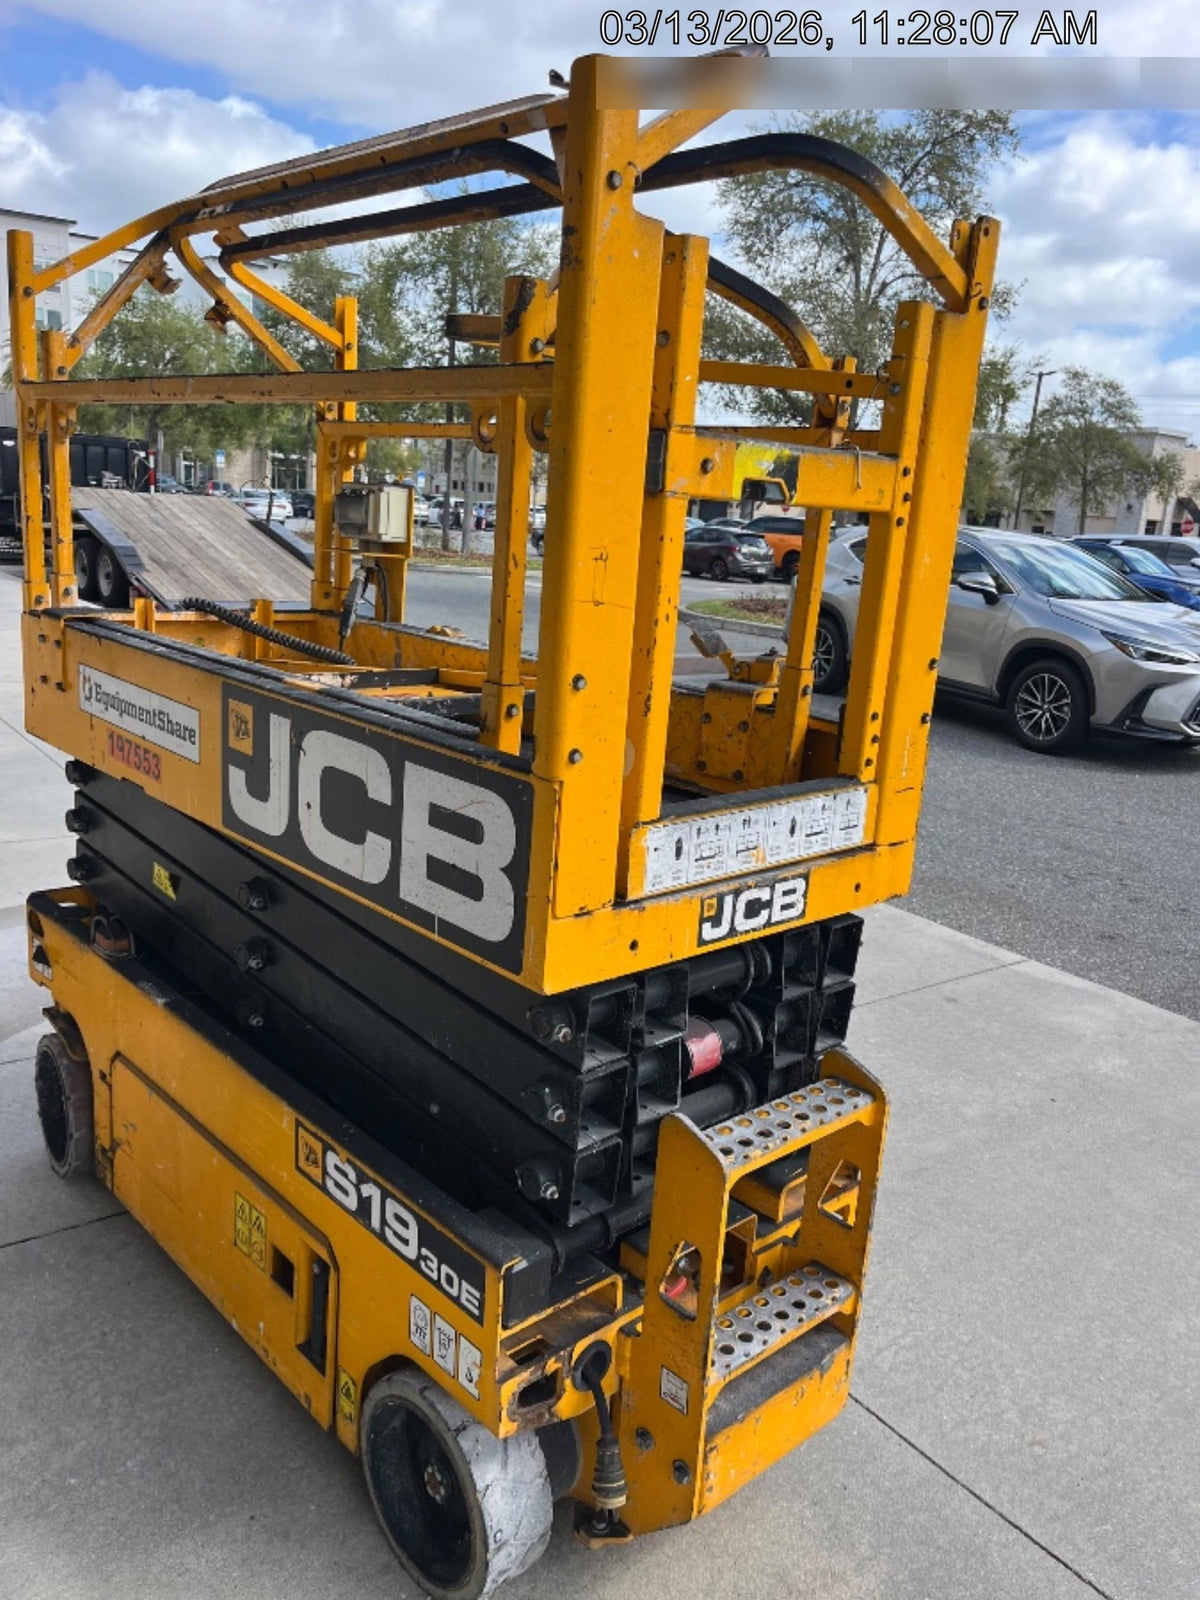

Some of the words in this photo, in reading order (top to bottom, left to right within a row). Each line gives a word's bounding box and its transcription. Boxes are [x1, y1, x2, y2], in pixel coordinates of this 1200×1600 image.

[94, 683, 197, 746] EquipmentShare
[107, 732, 161, 781] 197553
[228, 712, 516, 942] JCB
[702, 877, 807, 942] JCB
